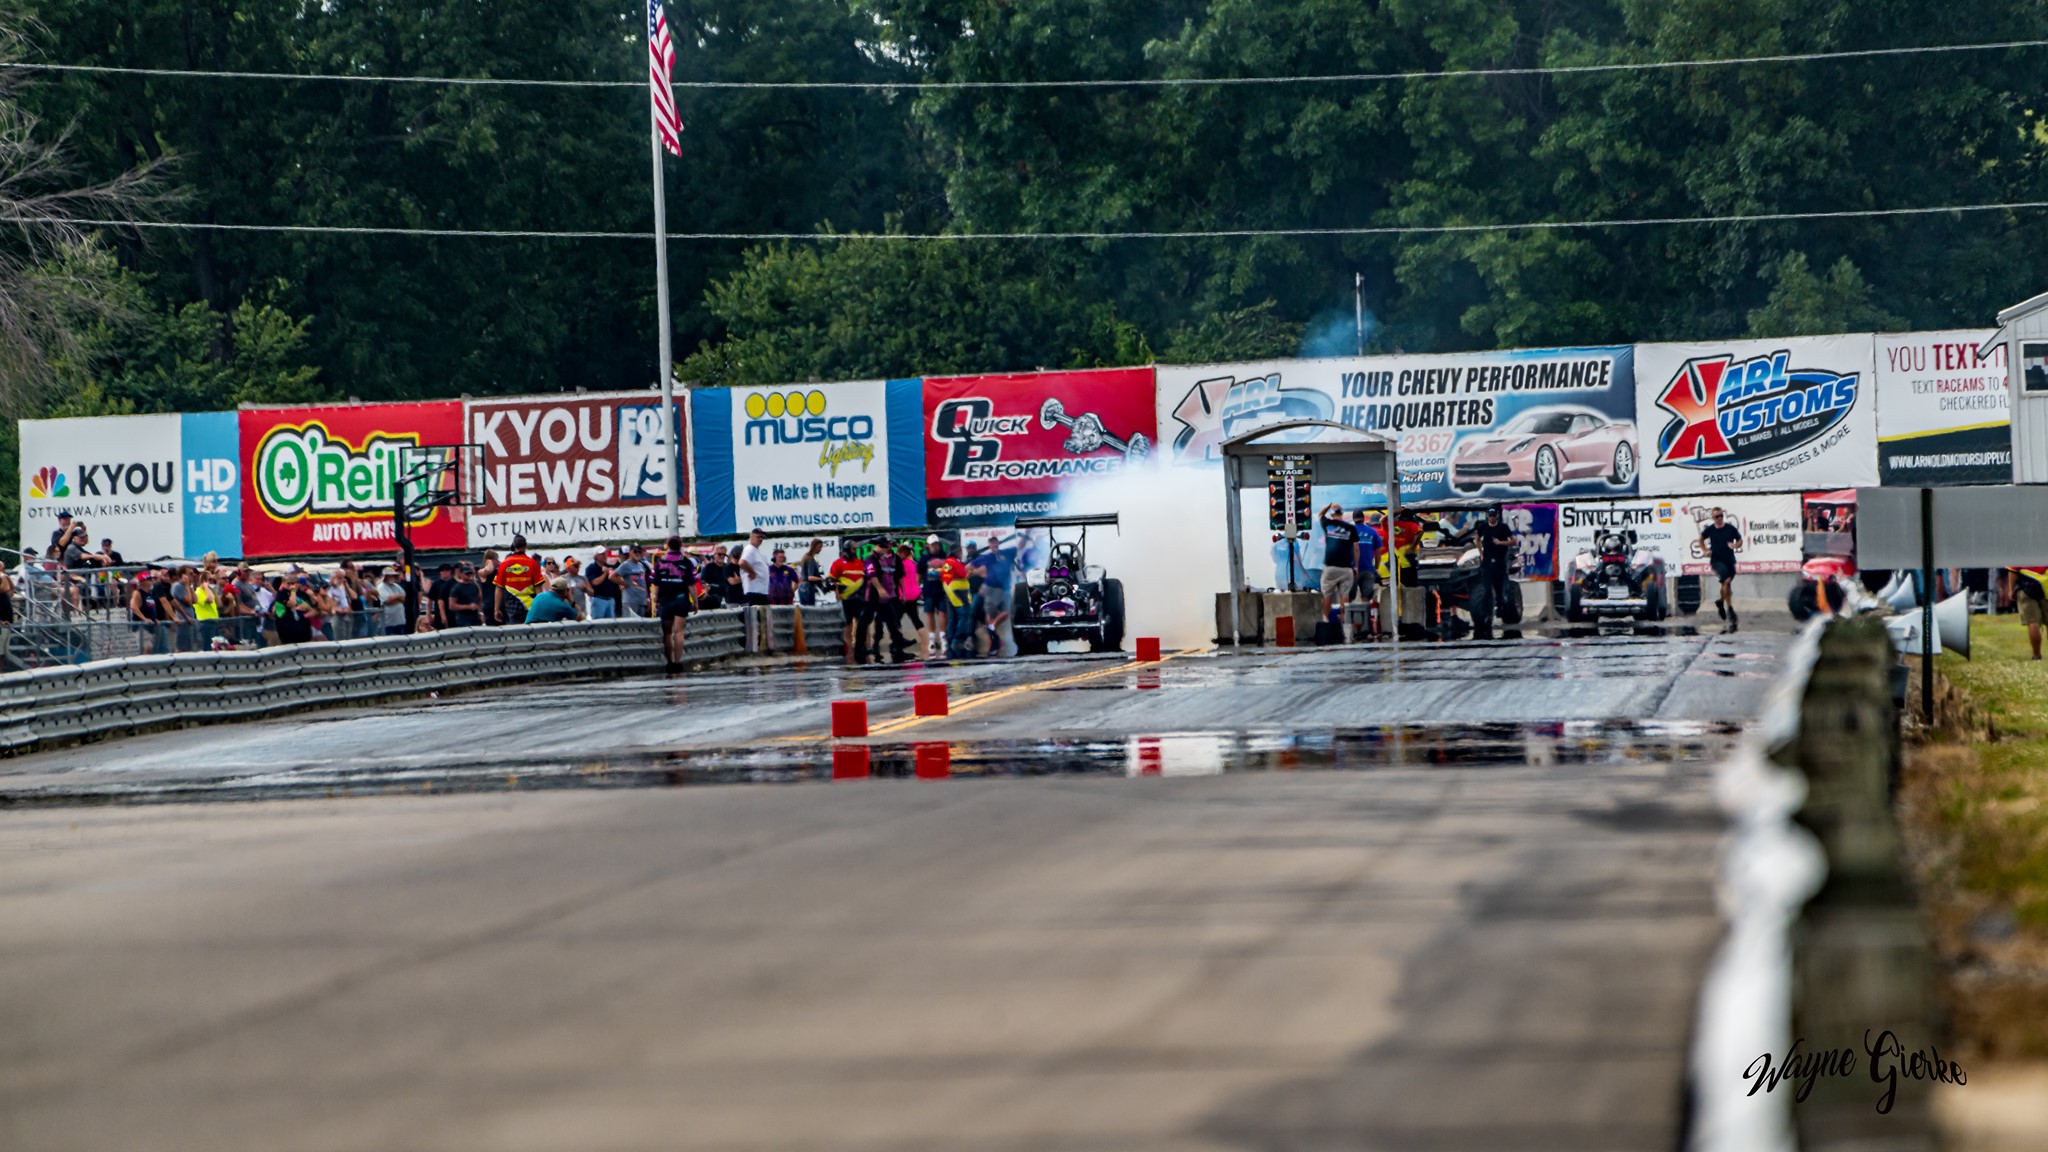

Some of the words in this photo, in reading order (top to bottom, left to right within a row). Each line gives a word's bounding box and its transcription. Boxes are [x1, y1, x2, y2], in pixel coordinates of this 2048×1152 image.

[1886, 346, 1926, 373] YOU
[1341, 371, 1392, 399] YOUR
[1398, 367, 1463, 396] CHEVY
[1465, 360, 1611, 393] PERFORMANCE
[1911, 380, 1934, 394] TEXT
[1936, 376, 1985, 393] RACEAMS
[1988, 376, 2000, 390] TO
[1341, 398, 1494, 431] HEADQUARTERS
[1939, 394, 1997, 411] CHECKERED
[474, 405, 612, 457] KYOU
[932, 397, 1032, 442] QUICK
[942, 437, 1122, 482] PERFORMANCE
[1740, 450, 1812, 482] ACCESSORIES
[1820, 423, 1852, 453] MORE
[78, 460, 174, 497] KYOU
[187, 458, 237, 493] HD
[474, 457, 615, 507] NEWS
[194, 495, 229, 514] 15.2
[748, 486, 768, 502] We
[772, 484, 809, 500] Make
[812, 483, 823, 499] It
[827, 482, 875, 502] Happen
[28, 501, 175, 519] OTTUMWA/KIRKSVILLE
[753, 511, 874, 527] www.musco.com
[936, 501, 1058, 518] QUICKPERFORMANCE.COM
[1562, 506, 1653, 528] SINCLAIR
[312, 521, 351, 542] AUTO
